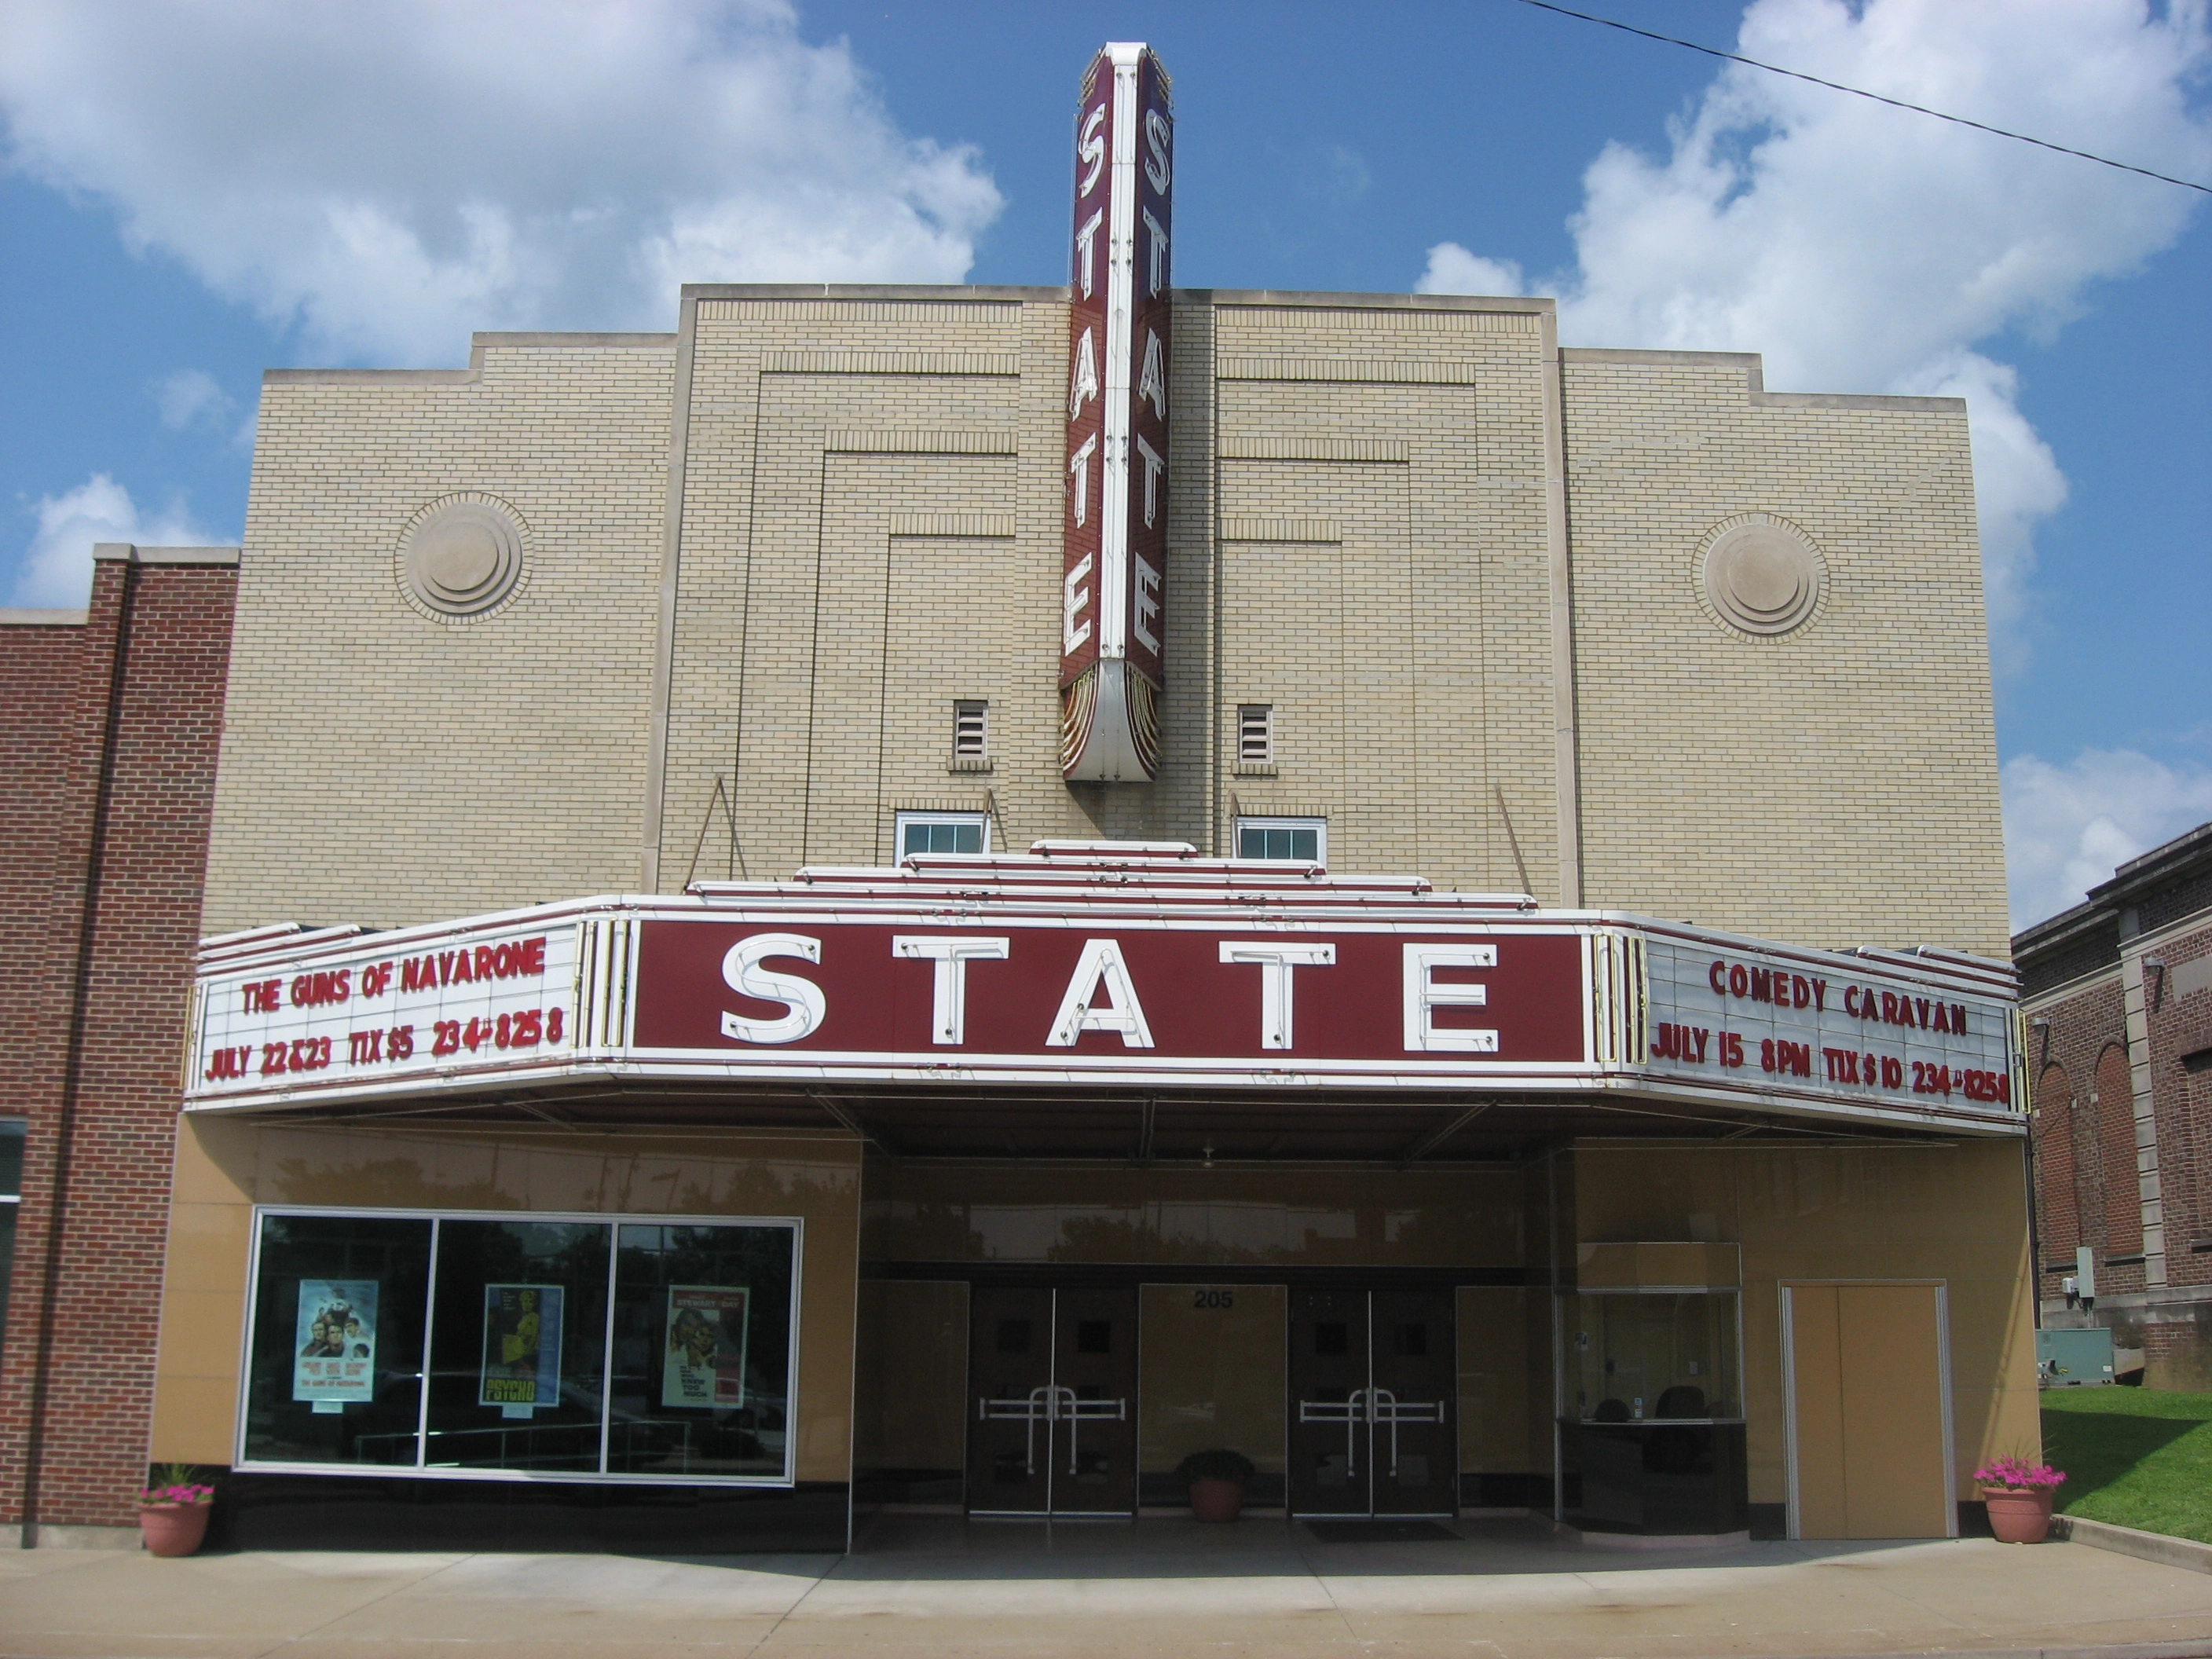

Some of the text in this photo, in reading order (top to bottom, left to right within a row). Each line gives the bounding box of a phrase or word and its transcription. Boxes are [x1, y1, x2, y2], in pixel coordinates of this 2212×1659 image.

[1064, 103, 1105, 657] STATE
[1133, 108, 1169, 658] STATE
[242, 937, 547, 1015] THE GUNS OF NAVARONE
[720, 932, 1499, 1053] STATE
[1709, 961, 1966, 1036] COMEDY CARAVAN
[205, 1045, 251, 1081] JULY
[261, 1035, 331, 1075] 22&23
[349, 1028, 383, 1067] TIX
[387, 1024, 413, 1060] $5
[1651, 1023, 1709, 1064] JULY
[1719, 1031, 1744, 1068] 15
[1760, 1038, 1811, 1078] 8PM
[1822, 1047, 1859, 1084] TIX
[1912, 1061, 2009, 1104] 234-8258
[1194, 1291, 1232, 1309] 205
[485, 1379, 535, 1401] PSYCHO
